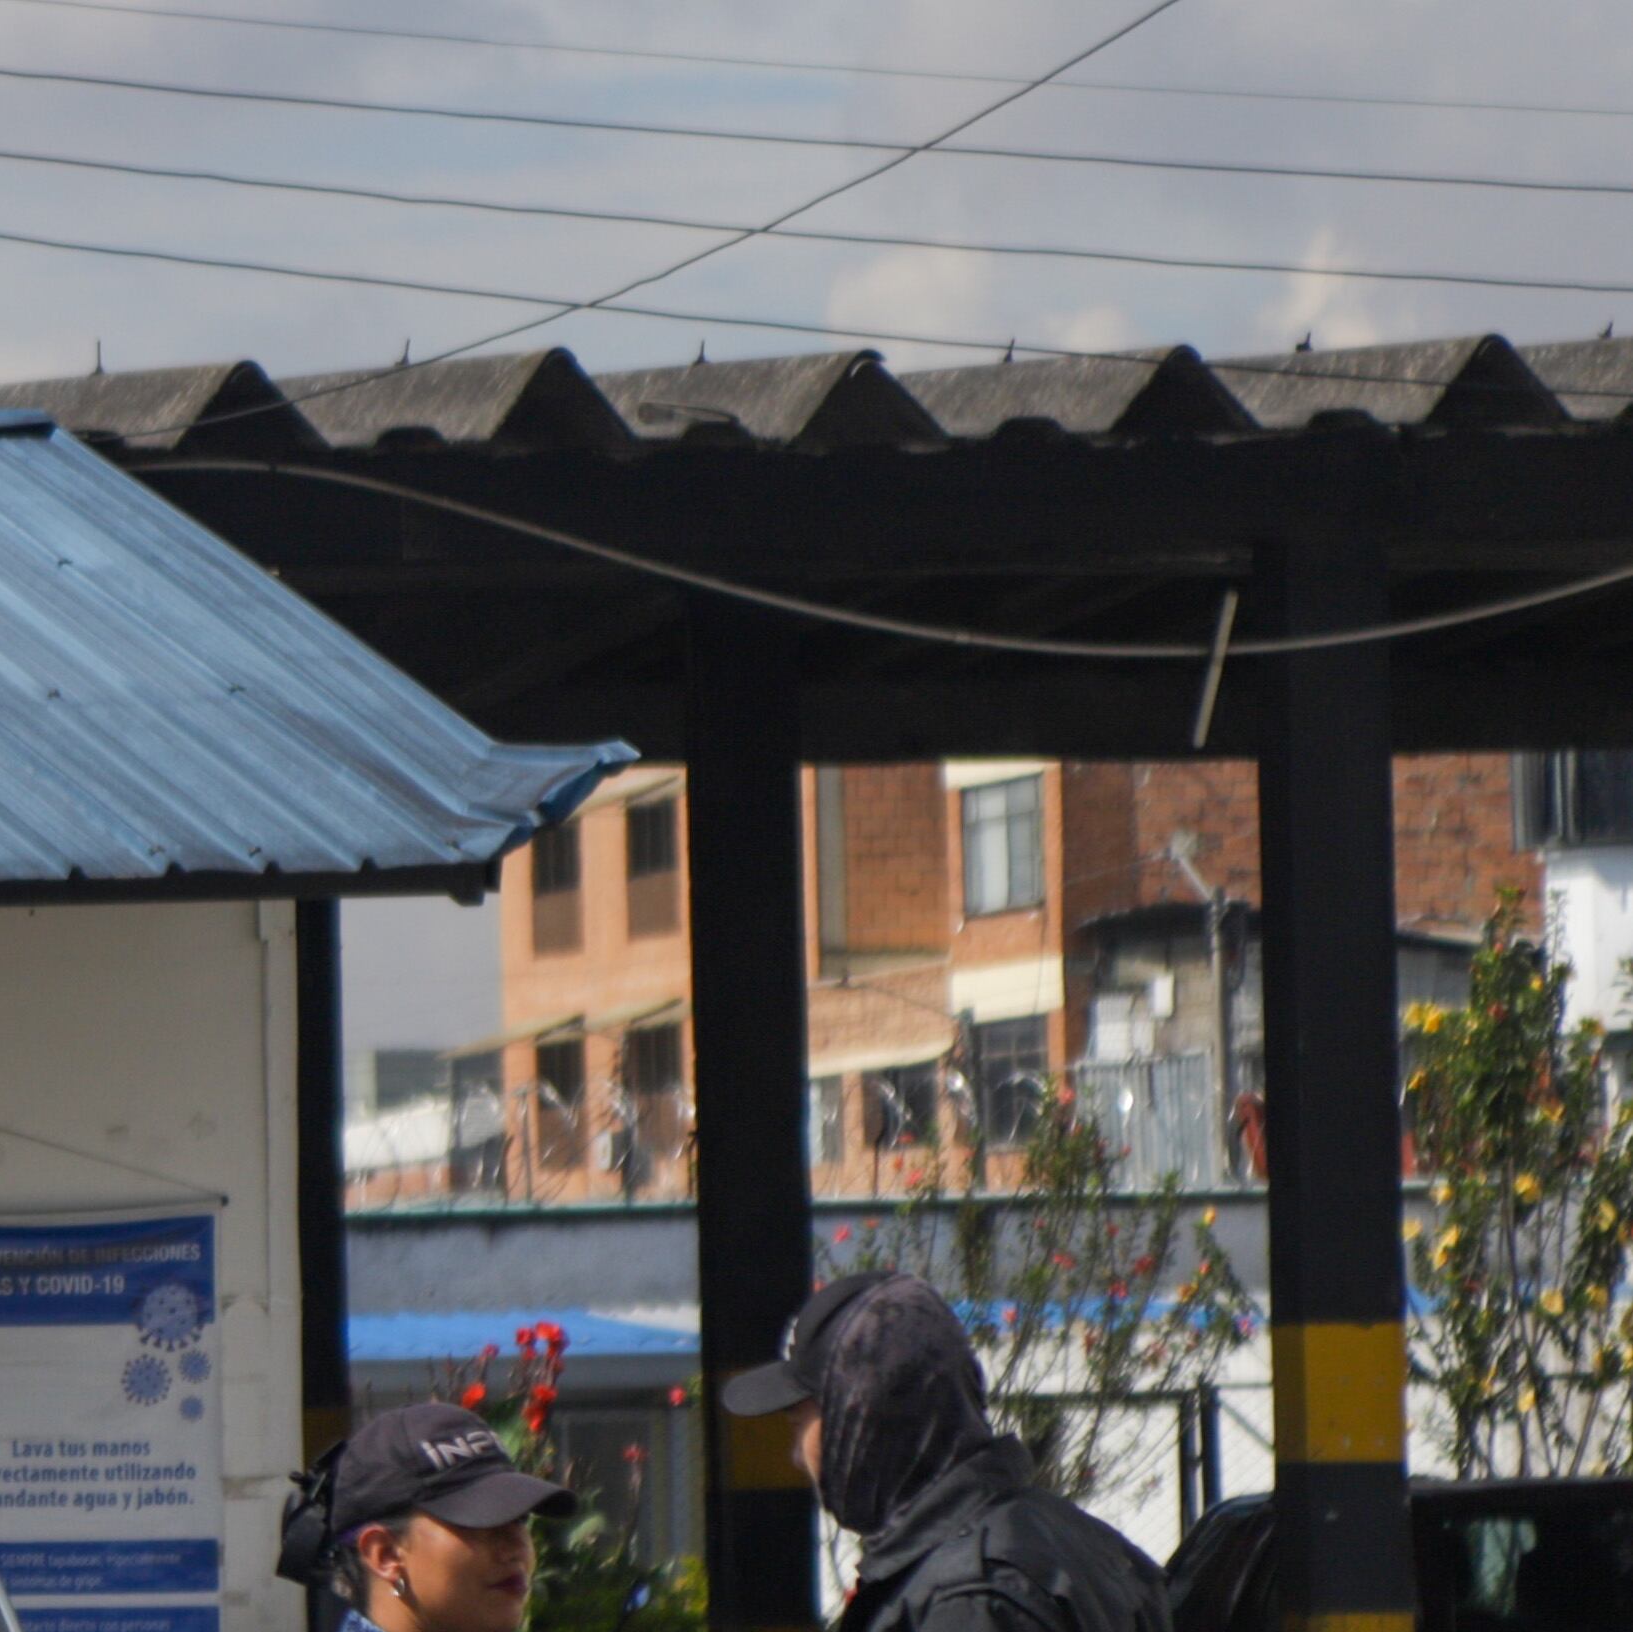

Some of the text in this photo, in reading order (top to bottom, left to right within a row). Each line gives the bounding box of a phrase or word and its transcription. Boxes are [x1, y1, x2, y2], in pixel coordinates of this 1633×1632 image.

[94, 1243, 201, 1263] INFECCIONES
[18, 1275, 31, 1296] Y
[36, 1274, 126, 1296] COVID-19
[12, 1439, 151, 1458] Lava tus manos
[104, 1462, 197, 1481] utilizando
[73, 1492, 118, 1511] agua
[122, 1492, 132, 1511] y
[137, 1487, 195, 1511] jabón.
